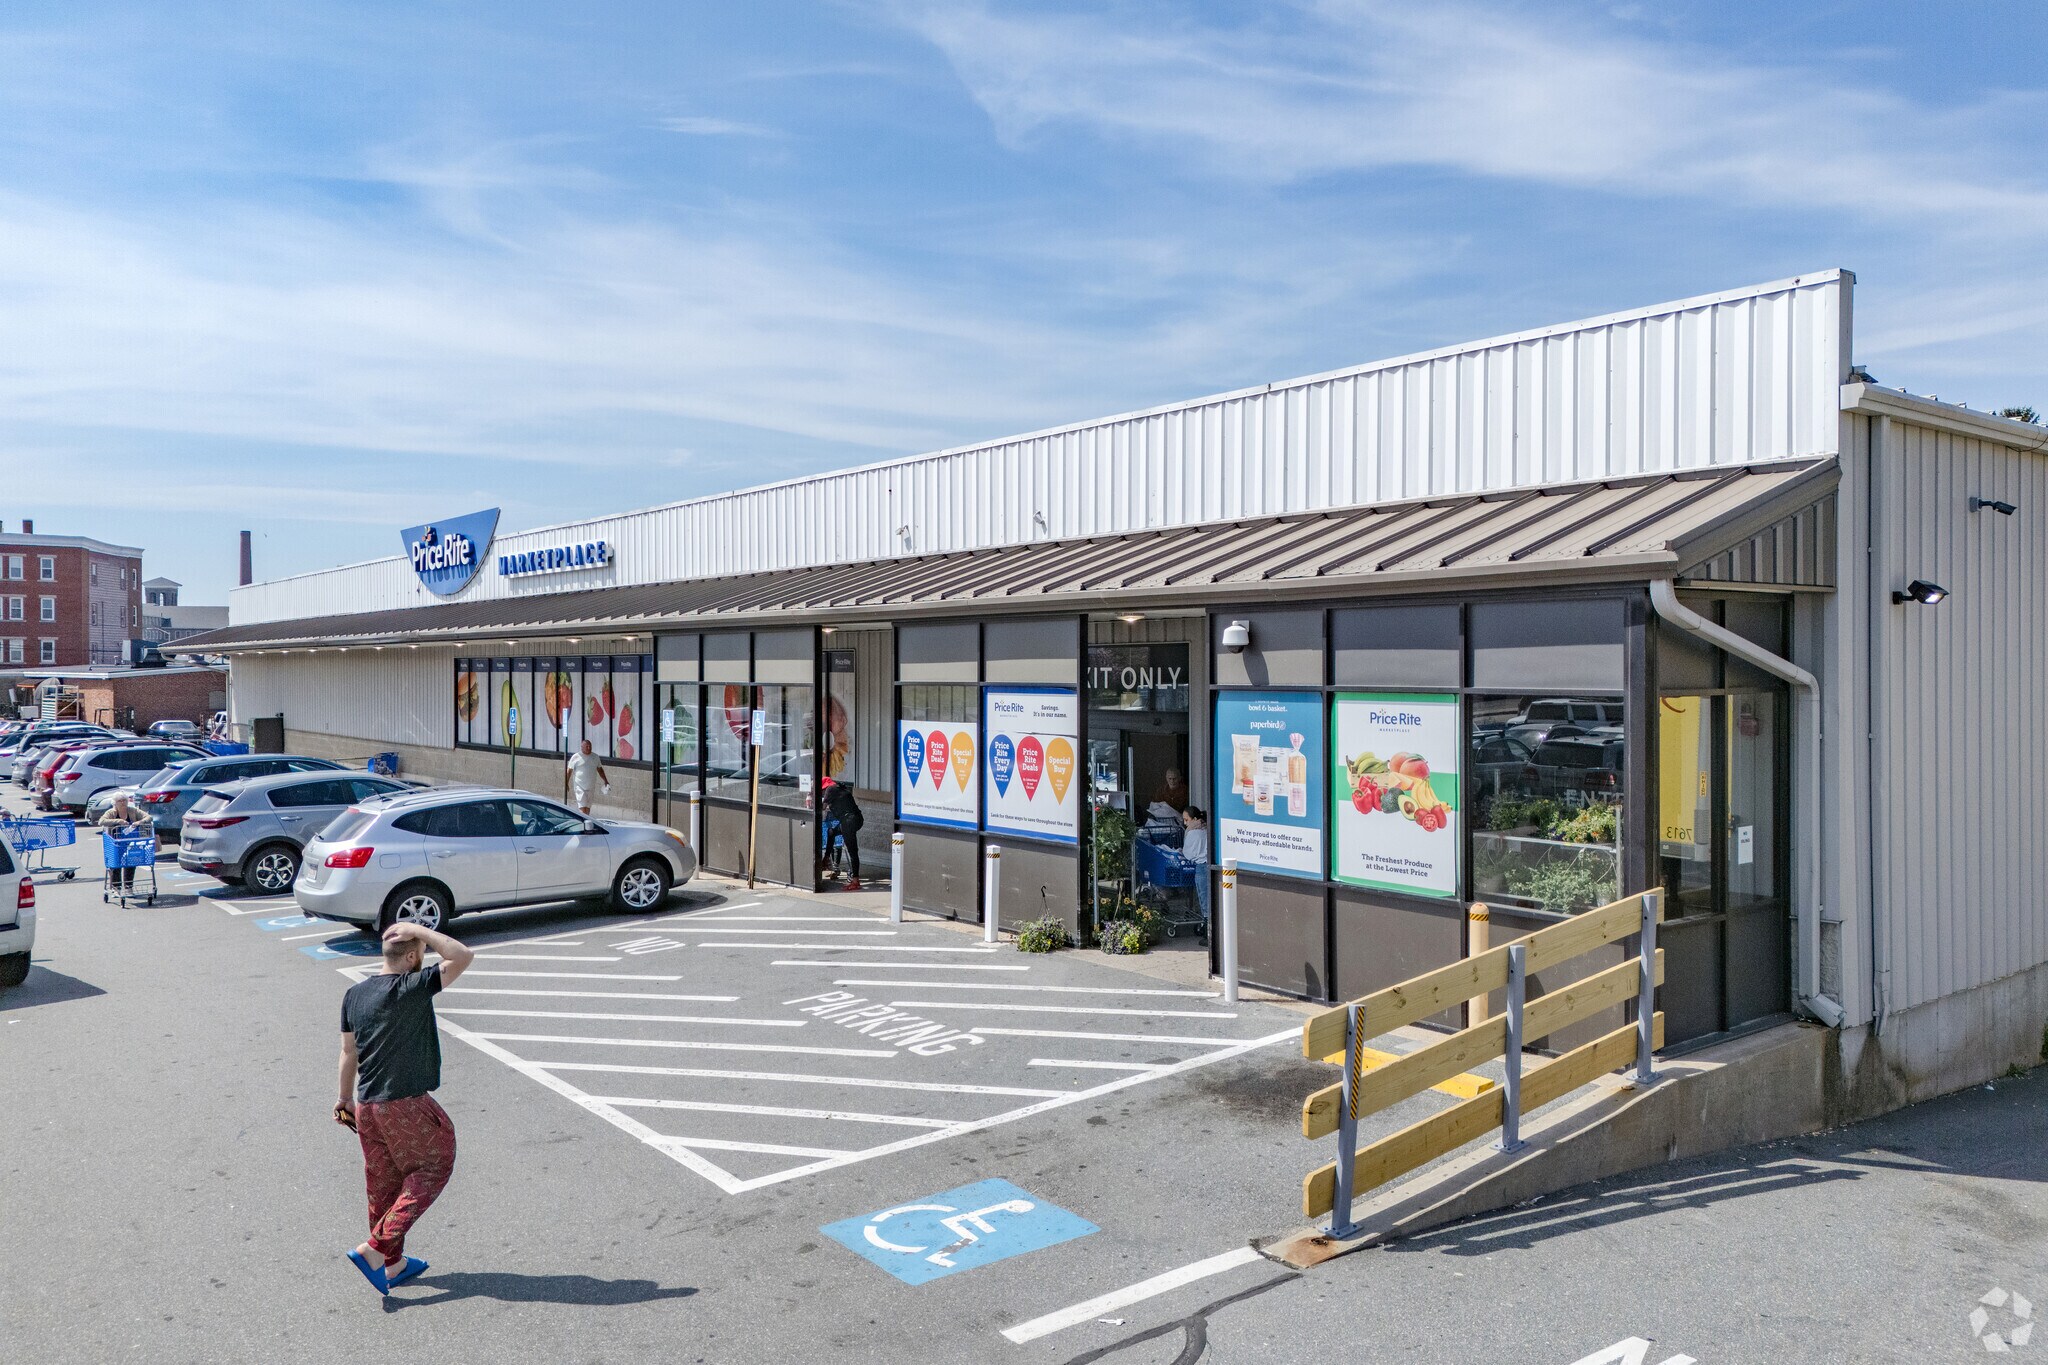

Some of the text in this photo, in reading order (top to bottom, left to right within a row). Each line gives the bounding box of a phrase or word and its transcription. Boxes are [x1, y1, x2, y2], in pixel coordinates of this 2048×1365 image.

[499, 542, 606, 576] MARKETPLACE
[1088, 667, 1181, 689] IT ONLY
[1250, 720, 1280, 730] paperbird
[1022, 748, 1038, 756] Price
[994, 756, 1010, 766] Every
[1048, 756, 1070, 765] Special
[997, 764, 1008, 773] Day
[1022, 763, 1038, 772] Deals
[1054, 765, 1066, 774] Buy
[1226, 835, 1314, 852] high quality, affordable brands.
[1375, 855, 1403, 864] Freshest
[1404, 859, 1432, 869] Produce
[1385, 865, 1409, 874] Lowest
[1410, 869, 1428, 877] Price
[608, 936, 686, 955] NO
[782, 991, 986, 1056] PARKING
